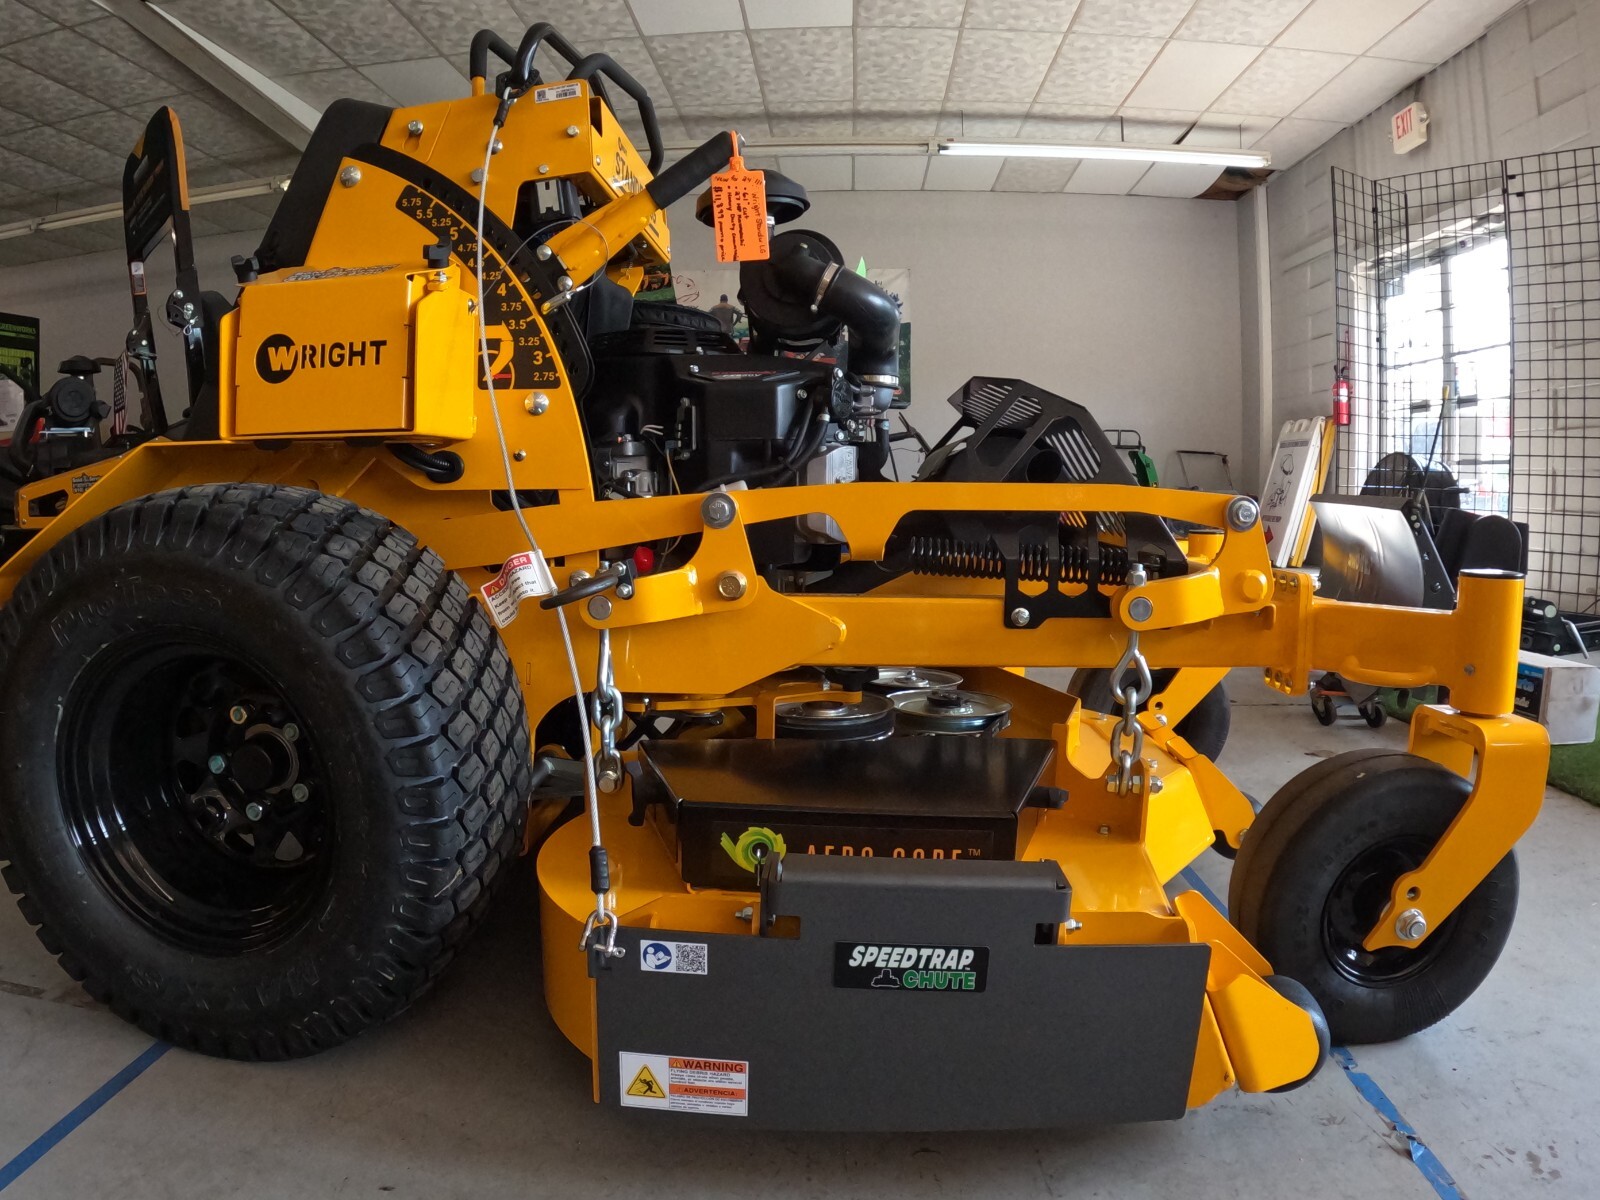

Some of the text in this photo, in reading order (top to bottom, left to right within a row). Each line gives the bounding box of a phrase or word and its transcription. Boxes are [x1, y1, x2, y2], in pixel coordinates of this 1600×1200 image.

[1395, 107, 1413, 140] EXIT
[402, 197, 422, 207] 5.75
[416, 208, 433, 219] 5.5
[431, 217, 452, 227] 5.25
[449, 226, 459, 240] 5
[457, 243, 478, 252] 4.75
[496, 282, 507, 297] 4
[500, 302, 522, 312] 3.75
[508, 319, 527, 330] 3.5
[518, 336, 540, 346] 3.25
[264, 338, 388, 373] WRIGHT
[533, 350, 543, 365] 3
[533, 372, 555, 381] 2.75
[848, 945, 975, 970] SPEEDTRAP
[902, 969, 977, 990] CHUTE
[683, 1060, 744, 1072] WARNING
[684, 1088, 734, 1096] ADVERTENCIA
